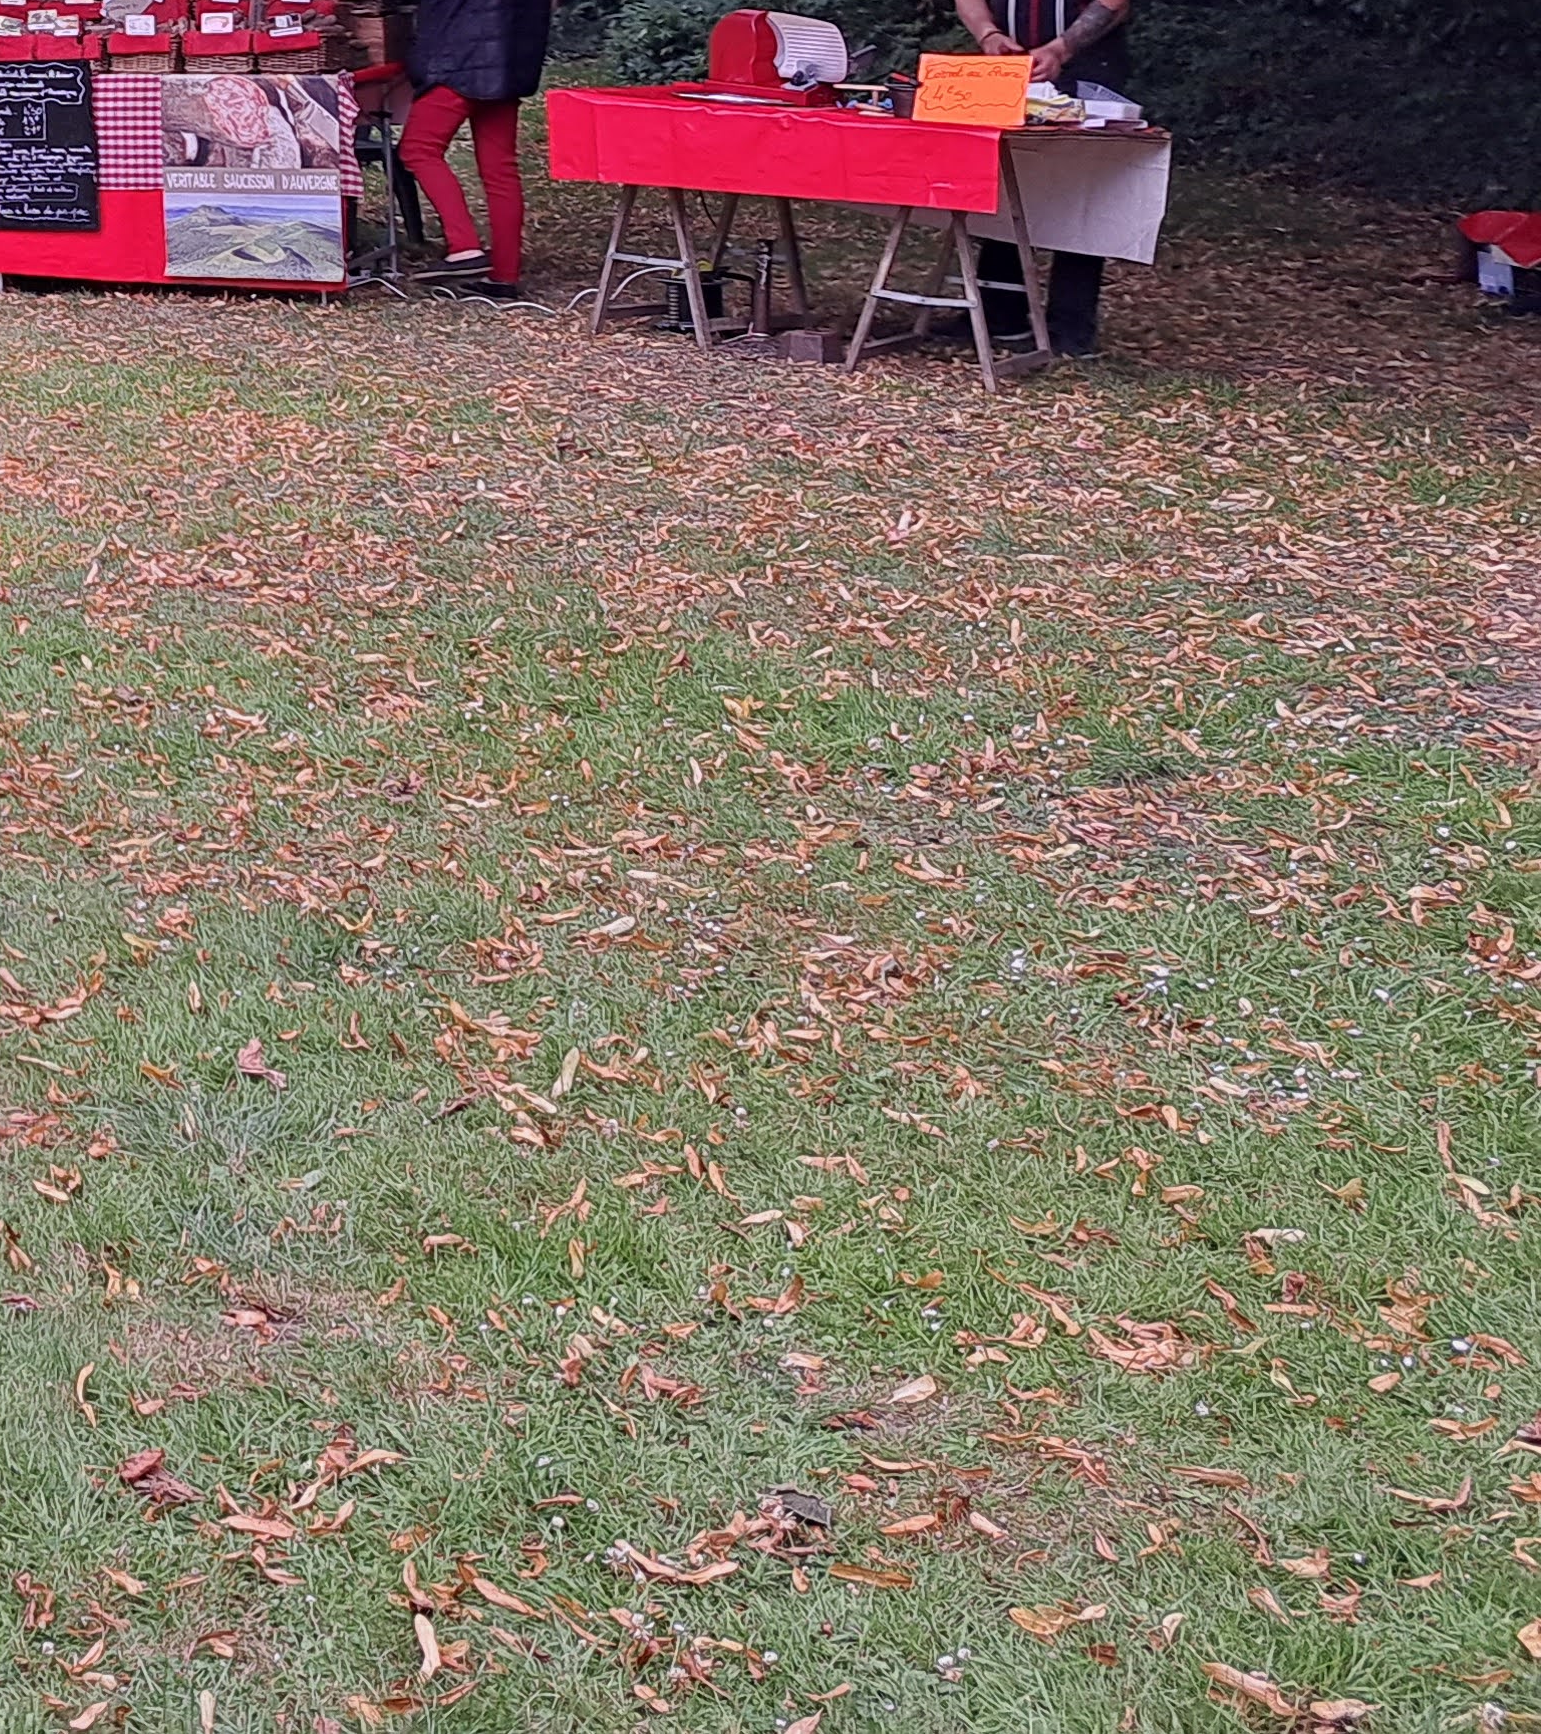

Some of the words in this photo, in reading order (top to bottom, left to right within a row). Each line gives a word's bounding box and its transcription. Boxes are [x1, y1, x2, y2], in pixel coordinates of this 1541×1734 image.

[166, 172, 217, 188] VERITABLE
[223, 173, 275, 190] SAUCISSON
[281, 175, 339, 192] D'AUVERGNE
